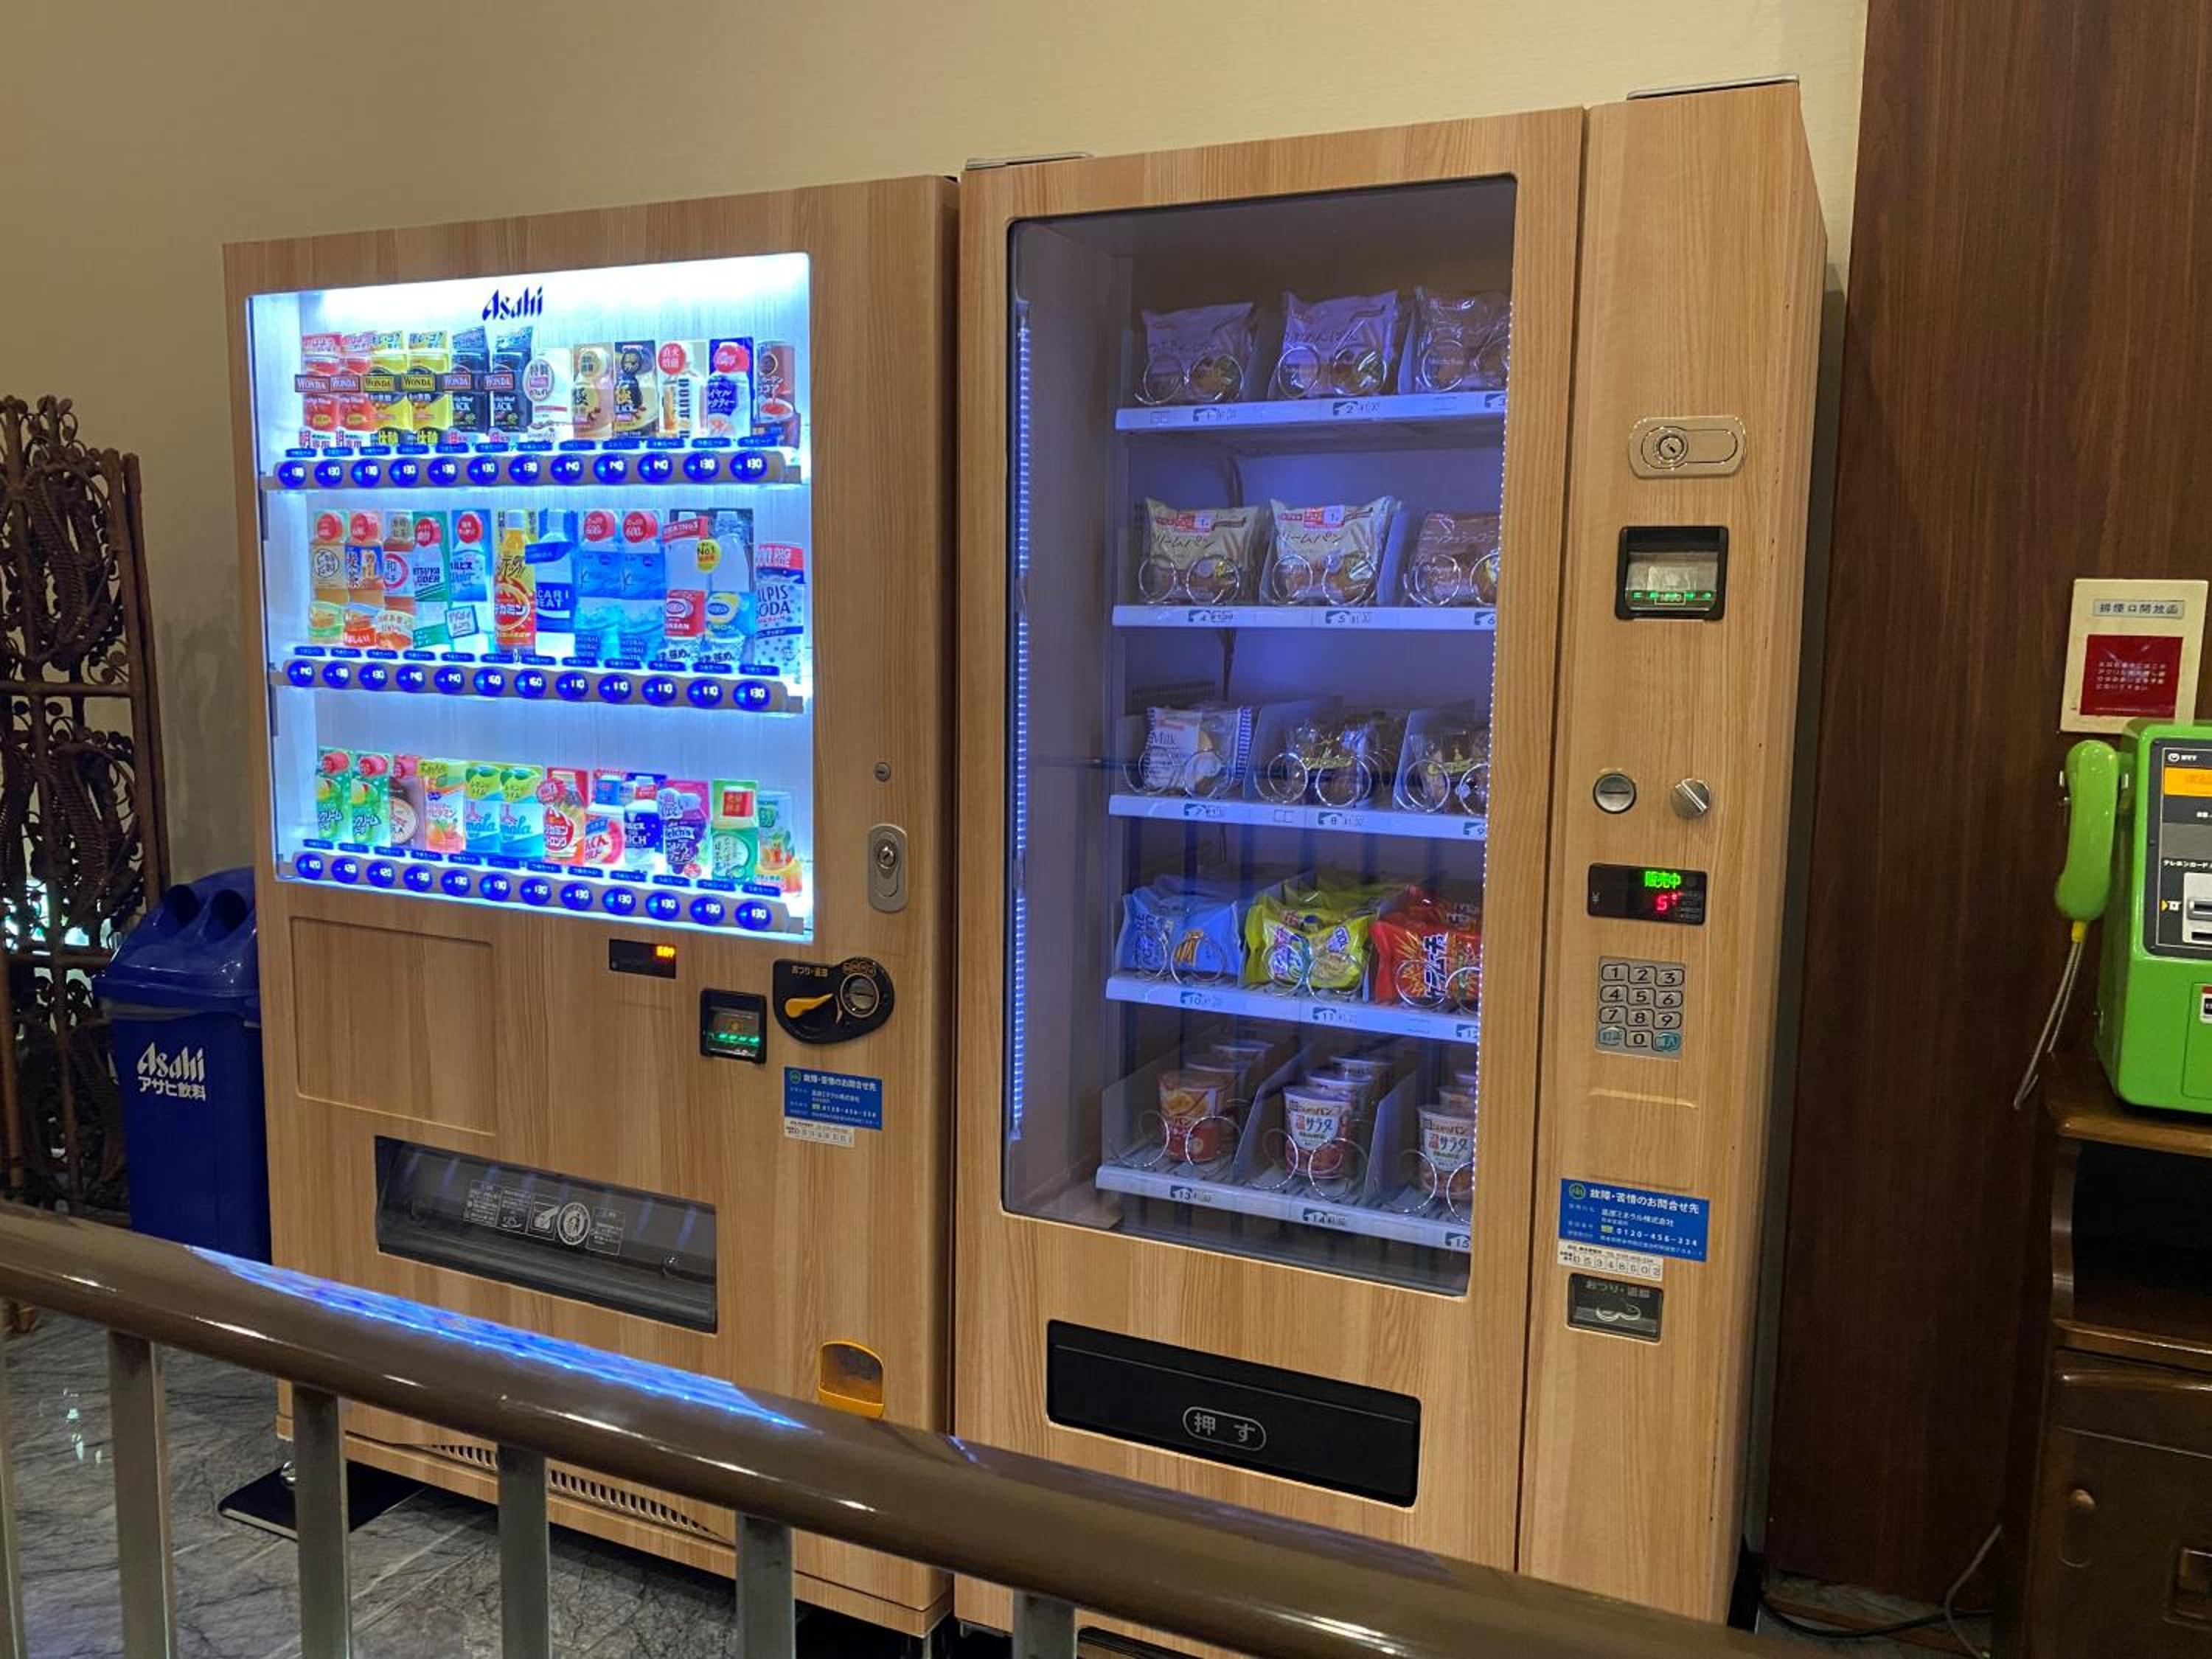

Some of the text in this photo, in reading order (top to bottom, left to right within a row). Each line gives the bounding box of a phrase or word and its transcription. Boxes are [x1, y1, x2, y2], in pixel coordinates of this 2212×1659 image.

[481, 285, 543, 321] Asahi
[297, 378, 326, 390] WONDA
[333, 378, 356, 388] WONDA
[365, 378, 392, 388] WONDA
[404, 378, 431, 388] WONDA
[444, 376, 469, 388] WONDA
[484, 376, 511, 388] WONDA
[1611, 967, 1618, 978] 1
[1638, 969, 1648, 981] 2
[1663, 973, 1676, 984] 3
[1609, 988, 1619, 999] 4
[1635, 990, 1647, 1002] 5
[1663, 993, 1674, 1005] 6
[1608, 1009, 1618, 1021] 7
[1635, 1012, 1645, 1023] 8
[1661, 1015, 1673, 1027] 9
[1633, 1033, 1645, 1045] 0
[136, 1042, 206, 1082] Asahi
[137, 1075, 206, 1101] アサヒ飲料
